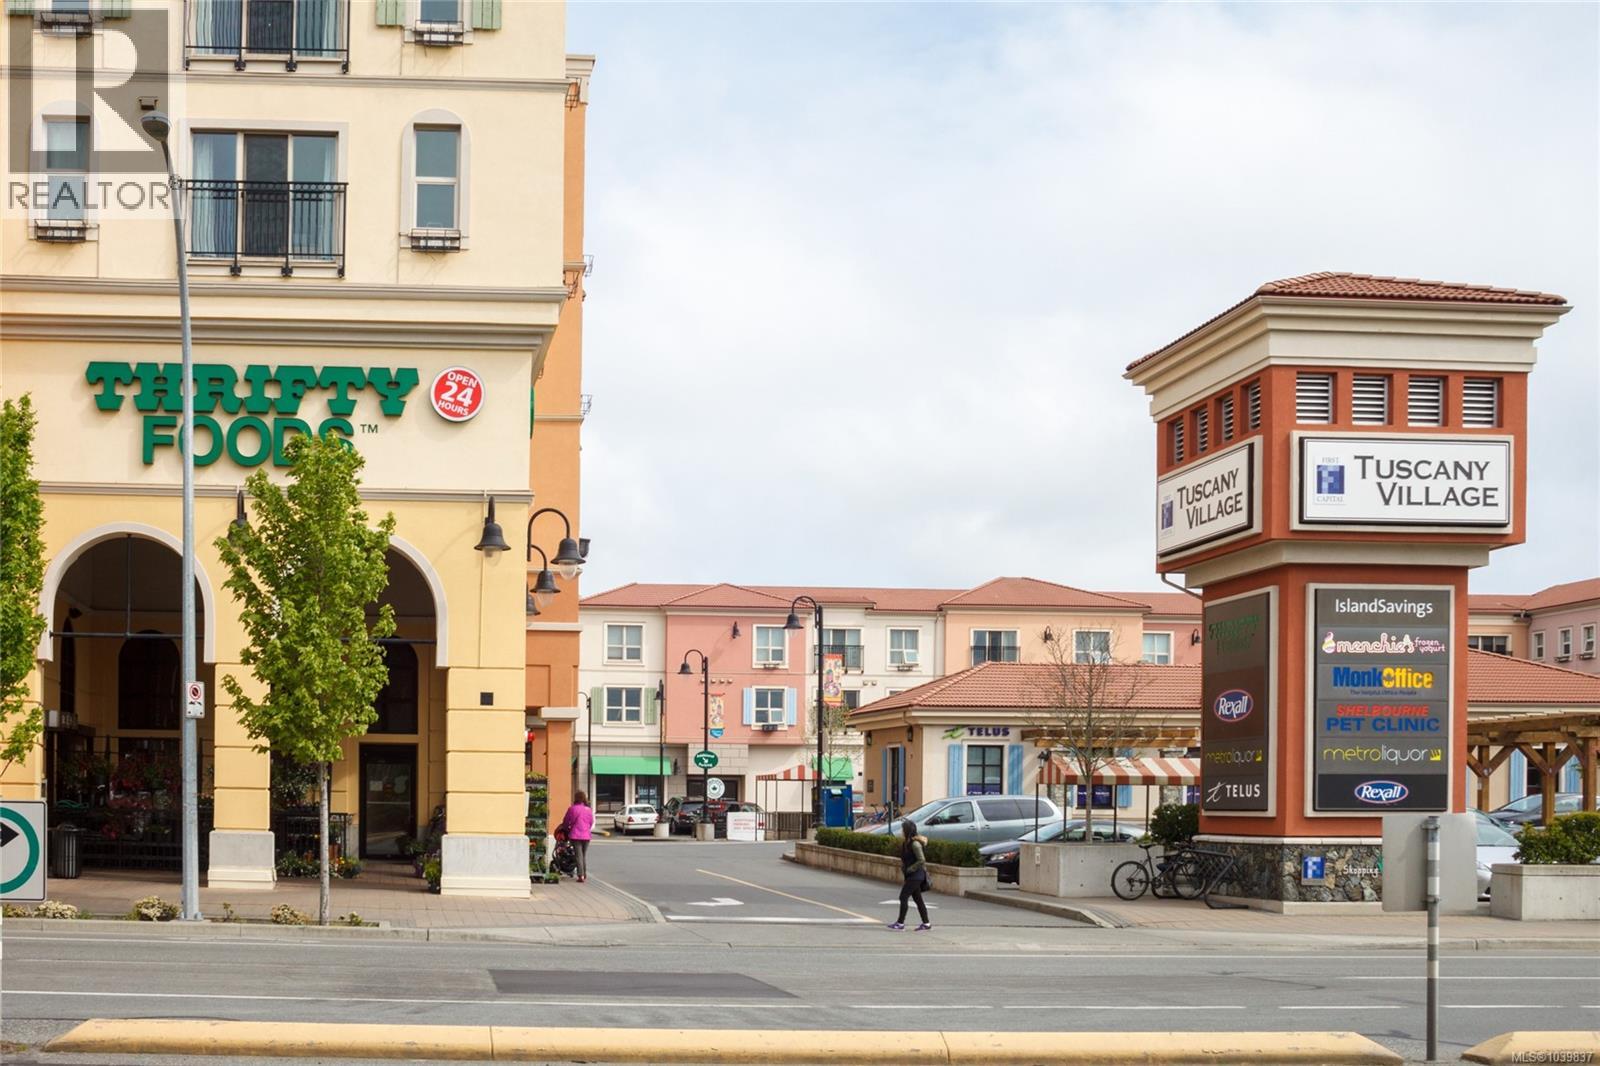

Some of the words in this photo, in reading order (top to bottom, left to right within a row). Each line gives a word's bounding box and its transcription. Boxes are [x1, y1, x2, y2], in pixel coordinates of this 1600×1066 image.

[86, 361, 419, 416] THRIFTY
[447, 371, 478, 388] OPEN
[440, 381, 474, 407] 24
[437, 400, 469, 416] HOURS
[1354, 455, 1490, 481] TUSCANY
[1177, 467, 1239, 510] TUSCANY
[1376, 481, 1499, 507] VILLAGE
[1186, 491, 1243, 530] VILLAGE
[1335, 597, 1434, 618] IslandSavings
[1414, 636, 1440, 646] frozen
[1420, 643, 1446, 653] yogurt
[1218, 696, 1248, 719] Rexall
[1336, 703, 1430, 717] SHELBOURNE
[967, 727, 1010, 737] TELUS
[1326, 718, 1365, 732] PET
[1371, 717, 1441, 732] CLINIC
[1323, 744, 1429, 766] metroliquor
[1225, 783, 1261, 798] TELUS
[1361, 785, 1401, 801] Rexall
